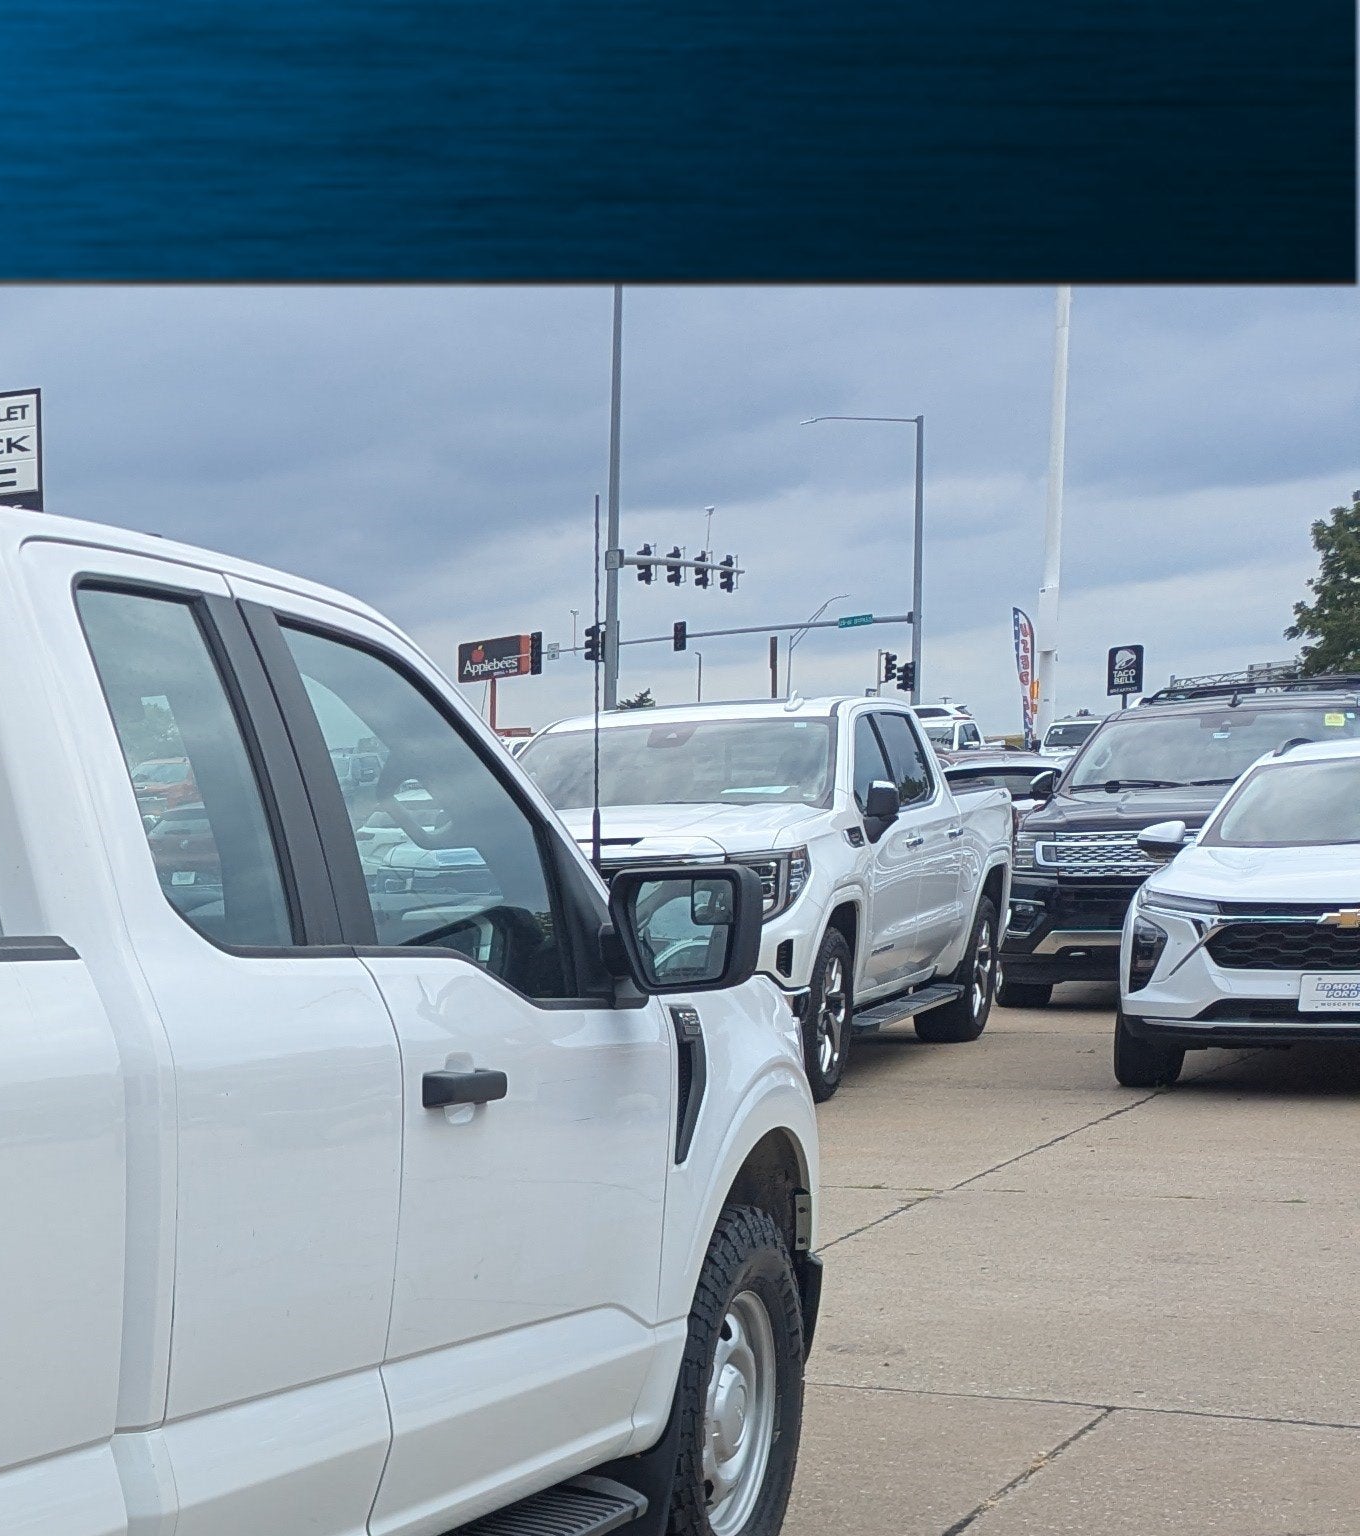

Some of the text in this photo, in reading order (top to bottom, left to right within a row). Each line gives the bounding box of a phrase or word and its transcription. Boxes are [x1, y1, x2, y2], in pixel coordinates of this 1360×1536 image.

[1112, 668, 1136, 678] TACO
[1113, 676, 1136, 684] BELL
[1326, 990, 1359, 999] FORD
